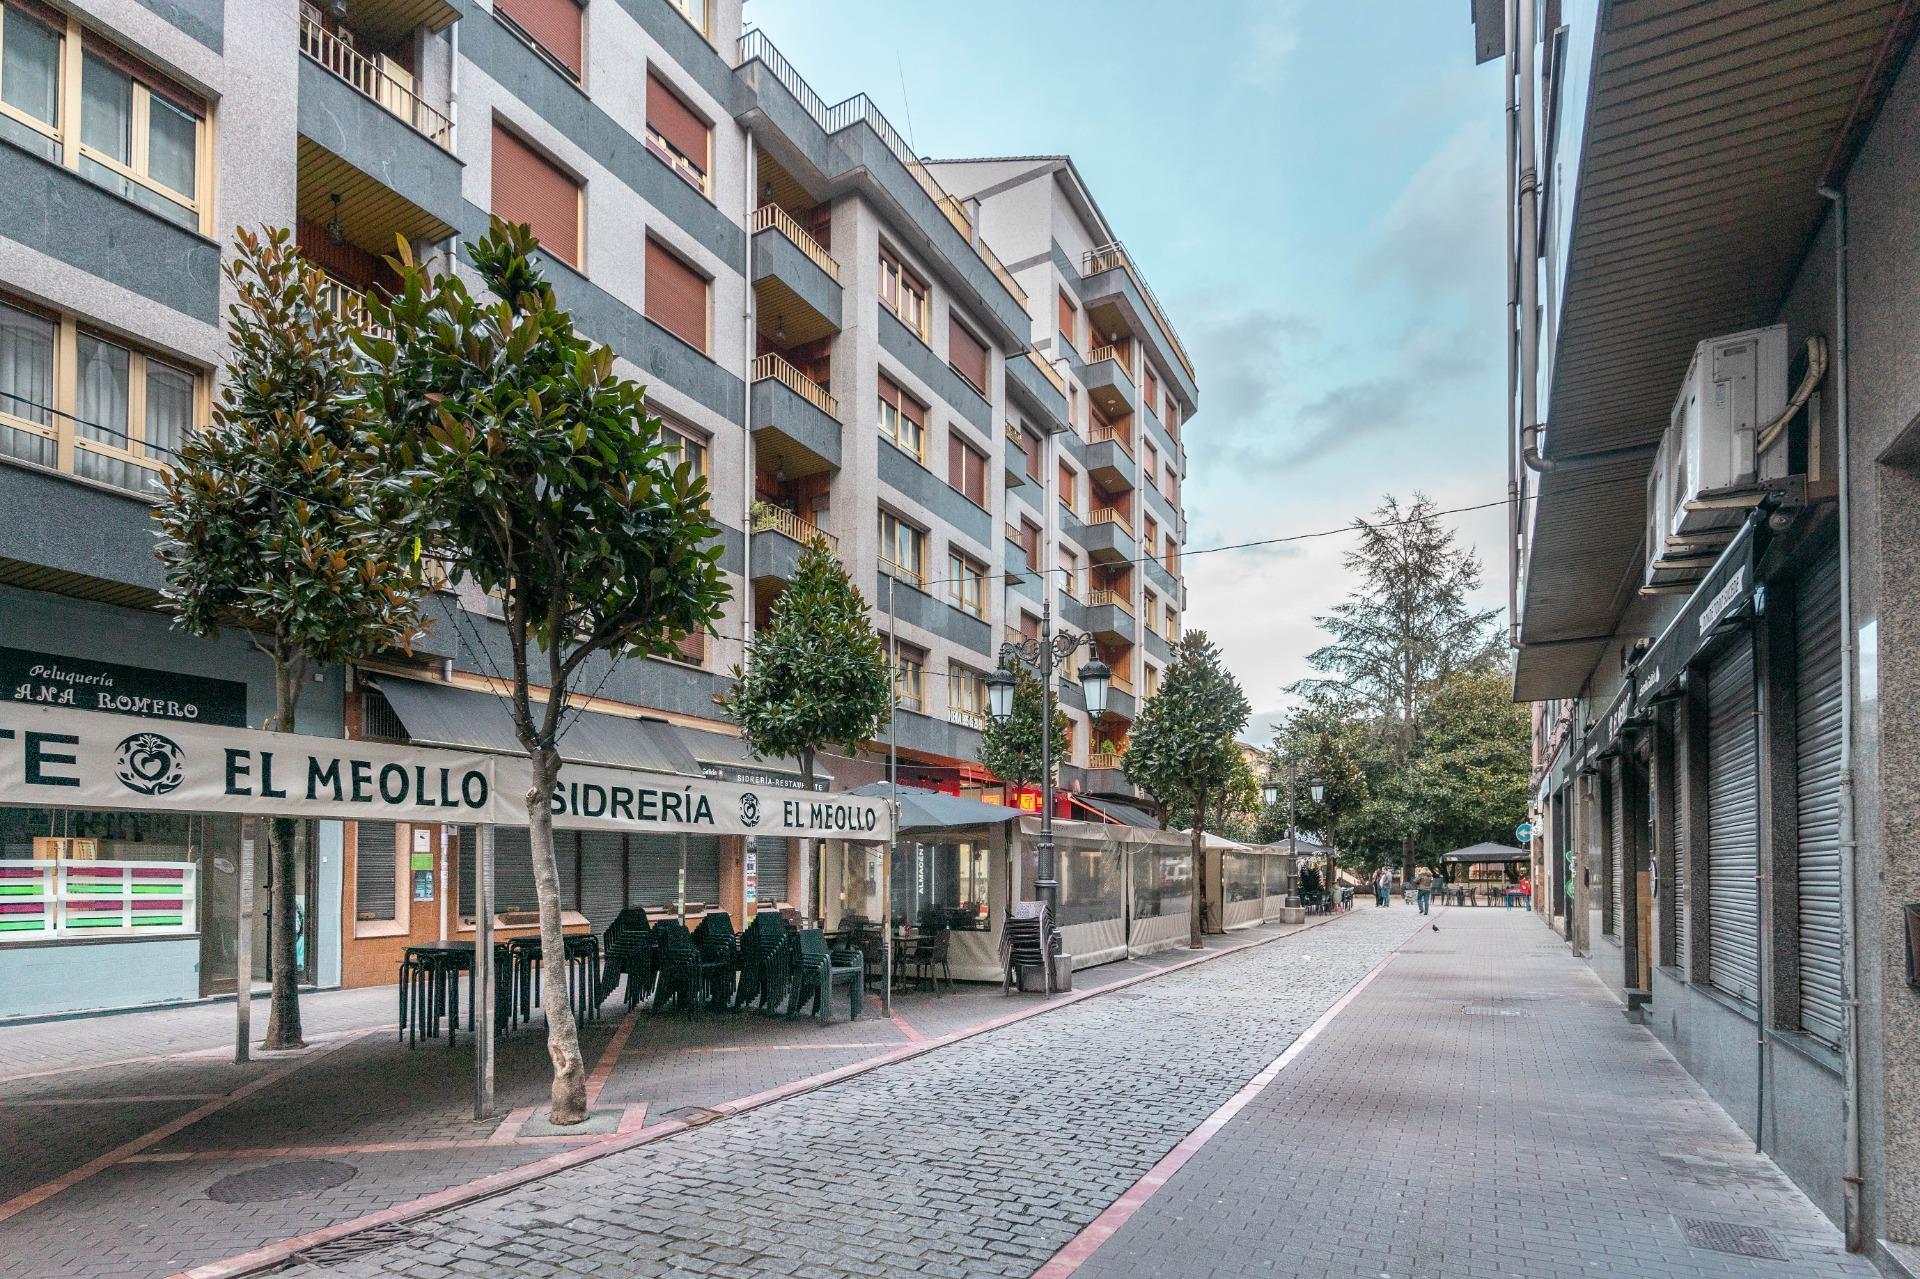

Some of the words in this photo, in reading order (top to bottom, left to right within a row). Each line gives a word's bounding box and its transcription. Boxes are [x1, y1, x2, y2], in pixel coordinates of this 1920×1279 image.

[29, 664, 114, 687] Peluquería
[14, 683, 76, 705] ANA
[97, 692, 198, 718] ROMERO
[0, 728, 80, 787] E
[224, 748, 287, 799] EL
[305, 755, 489, 809] MEOLLO
[550, 780, 715, 825] SIDRERÍA
[783, 800, 804, 828] EL
[809, 803, 876, 831] MEOLLO
